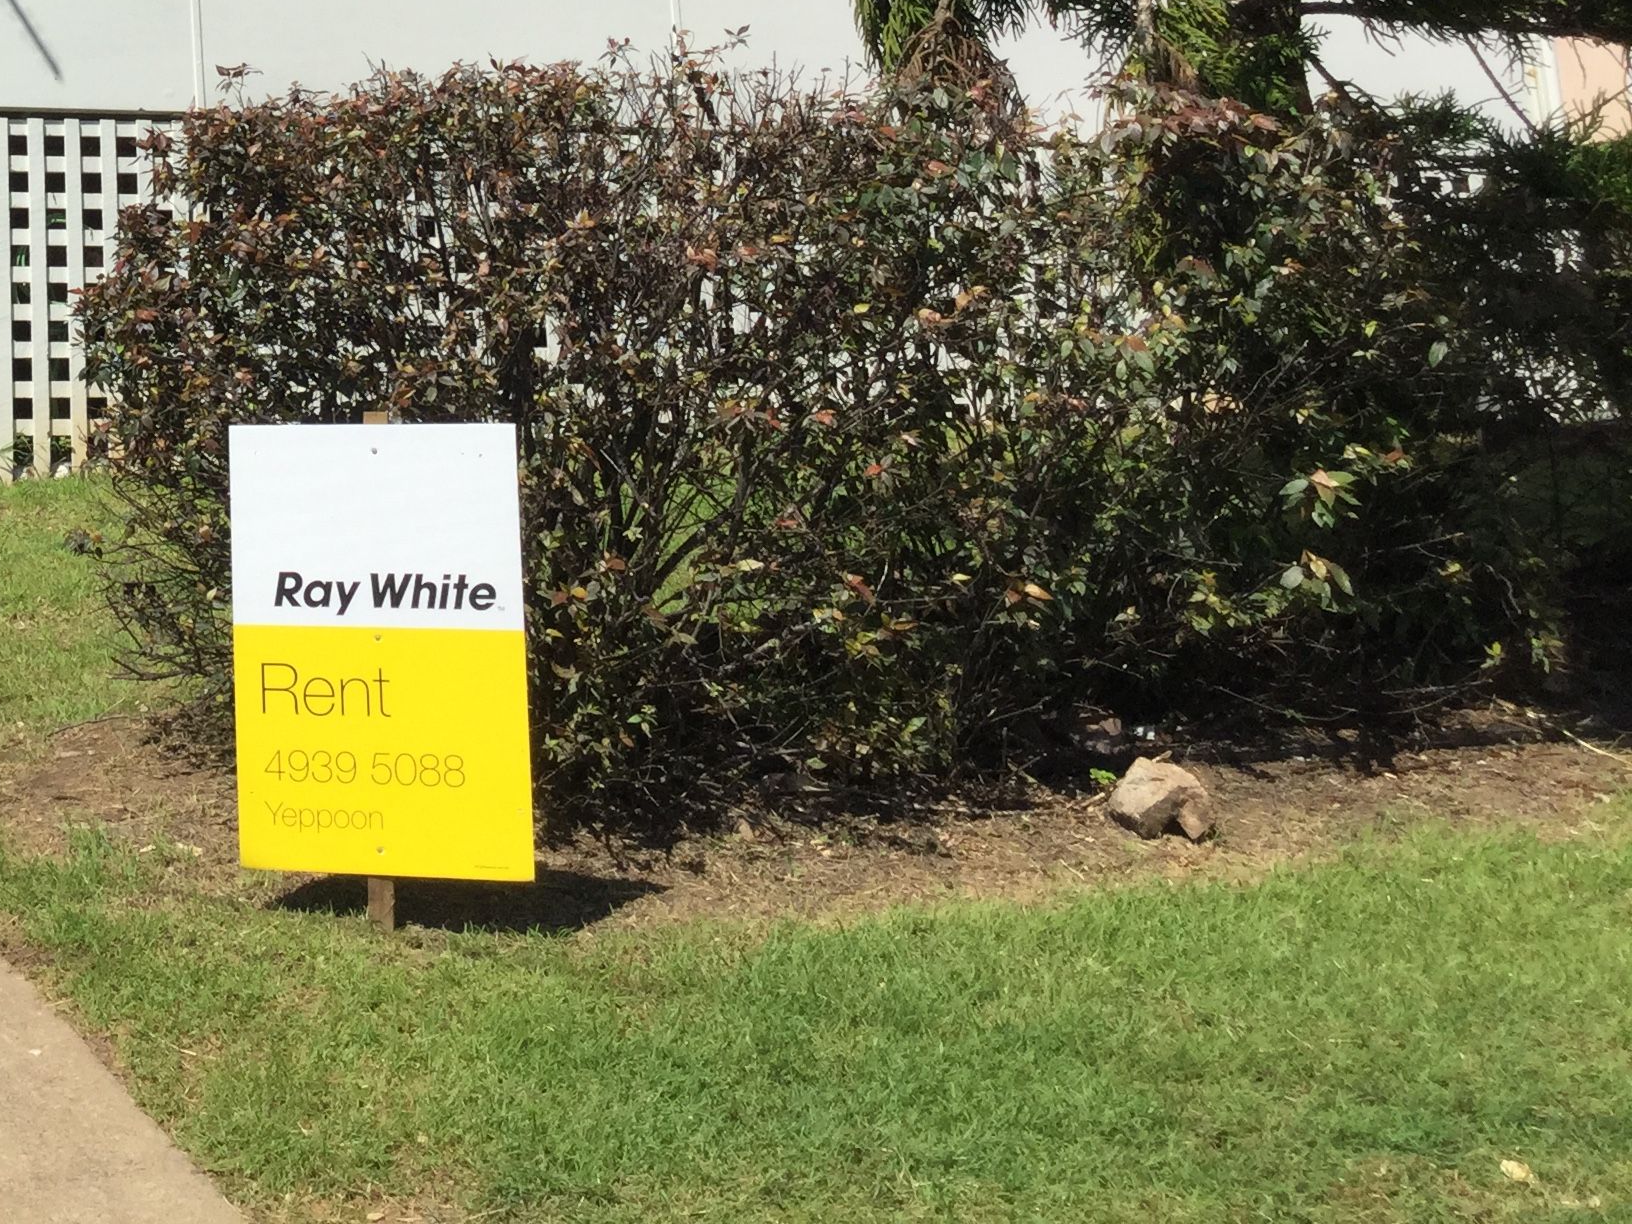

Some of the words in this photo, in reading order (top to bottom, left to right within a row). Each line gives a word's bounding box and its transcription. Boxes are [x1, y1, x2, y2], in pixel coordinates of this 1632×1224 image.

[273, 570, 361, 616] Ray
[369, 572, 497, 612] White
[260, 662, 392, 718] Rent
[263, 749, 357, 785] 4939
[370, 751, 466, 789] 5088
[263, 800, 384, 834] Yeppoon
